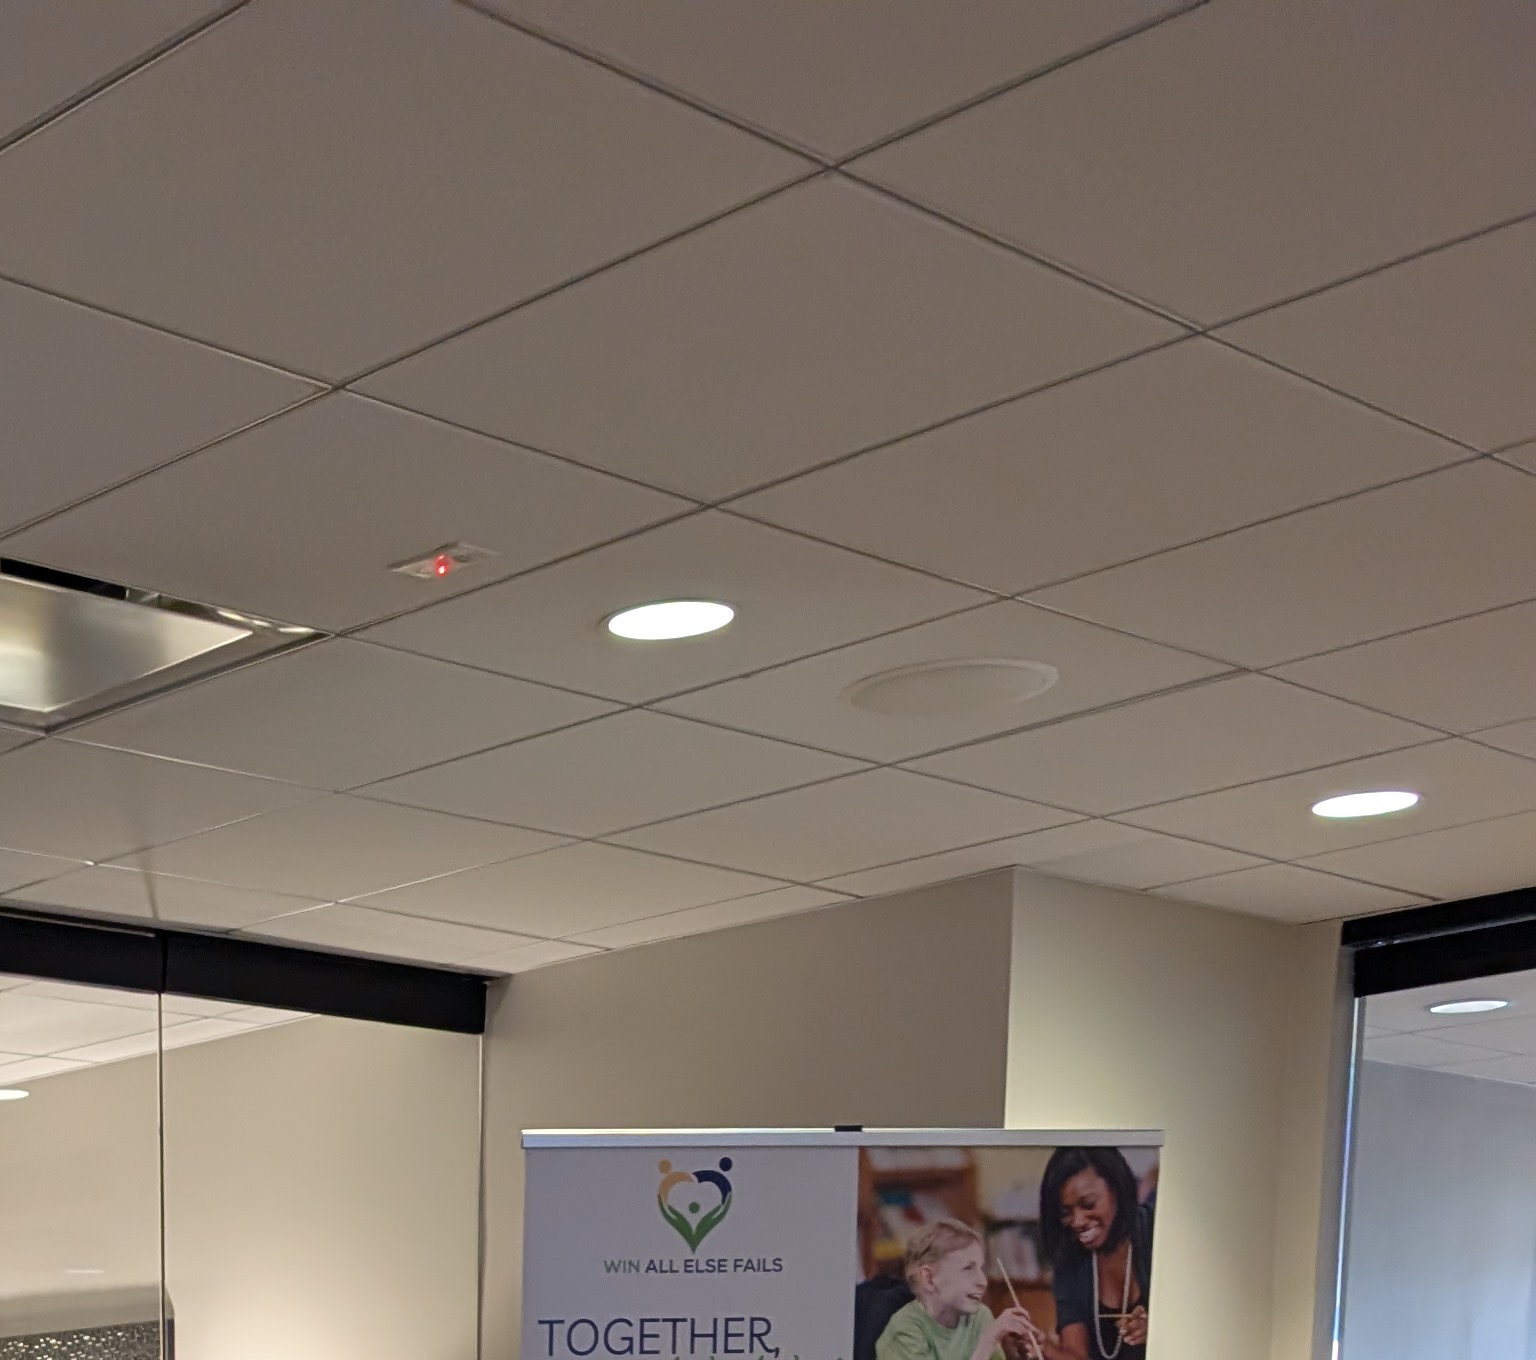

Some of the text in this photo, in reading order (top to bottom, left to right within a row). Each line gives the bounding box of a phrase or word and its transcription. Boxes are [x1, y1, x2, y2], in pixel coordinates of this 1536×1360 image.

[603, 1257, 783, 1273] WIN ALL ELSE FAILS
[537, 1316, 779, 1358] TOGETHER,
